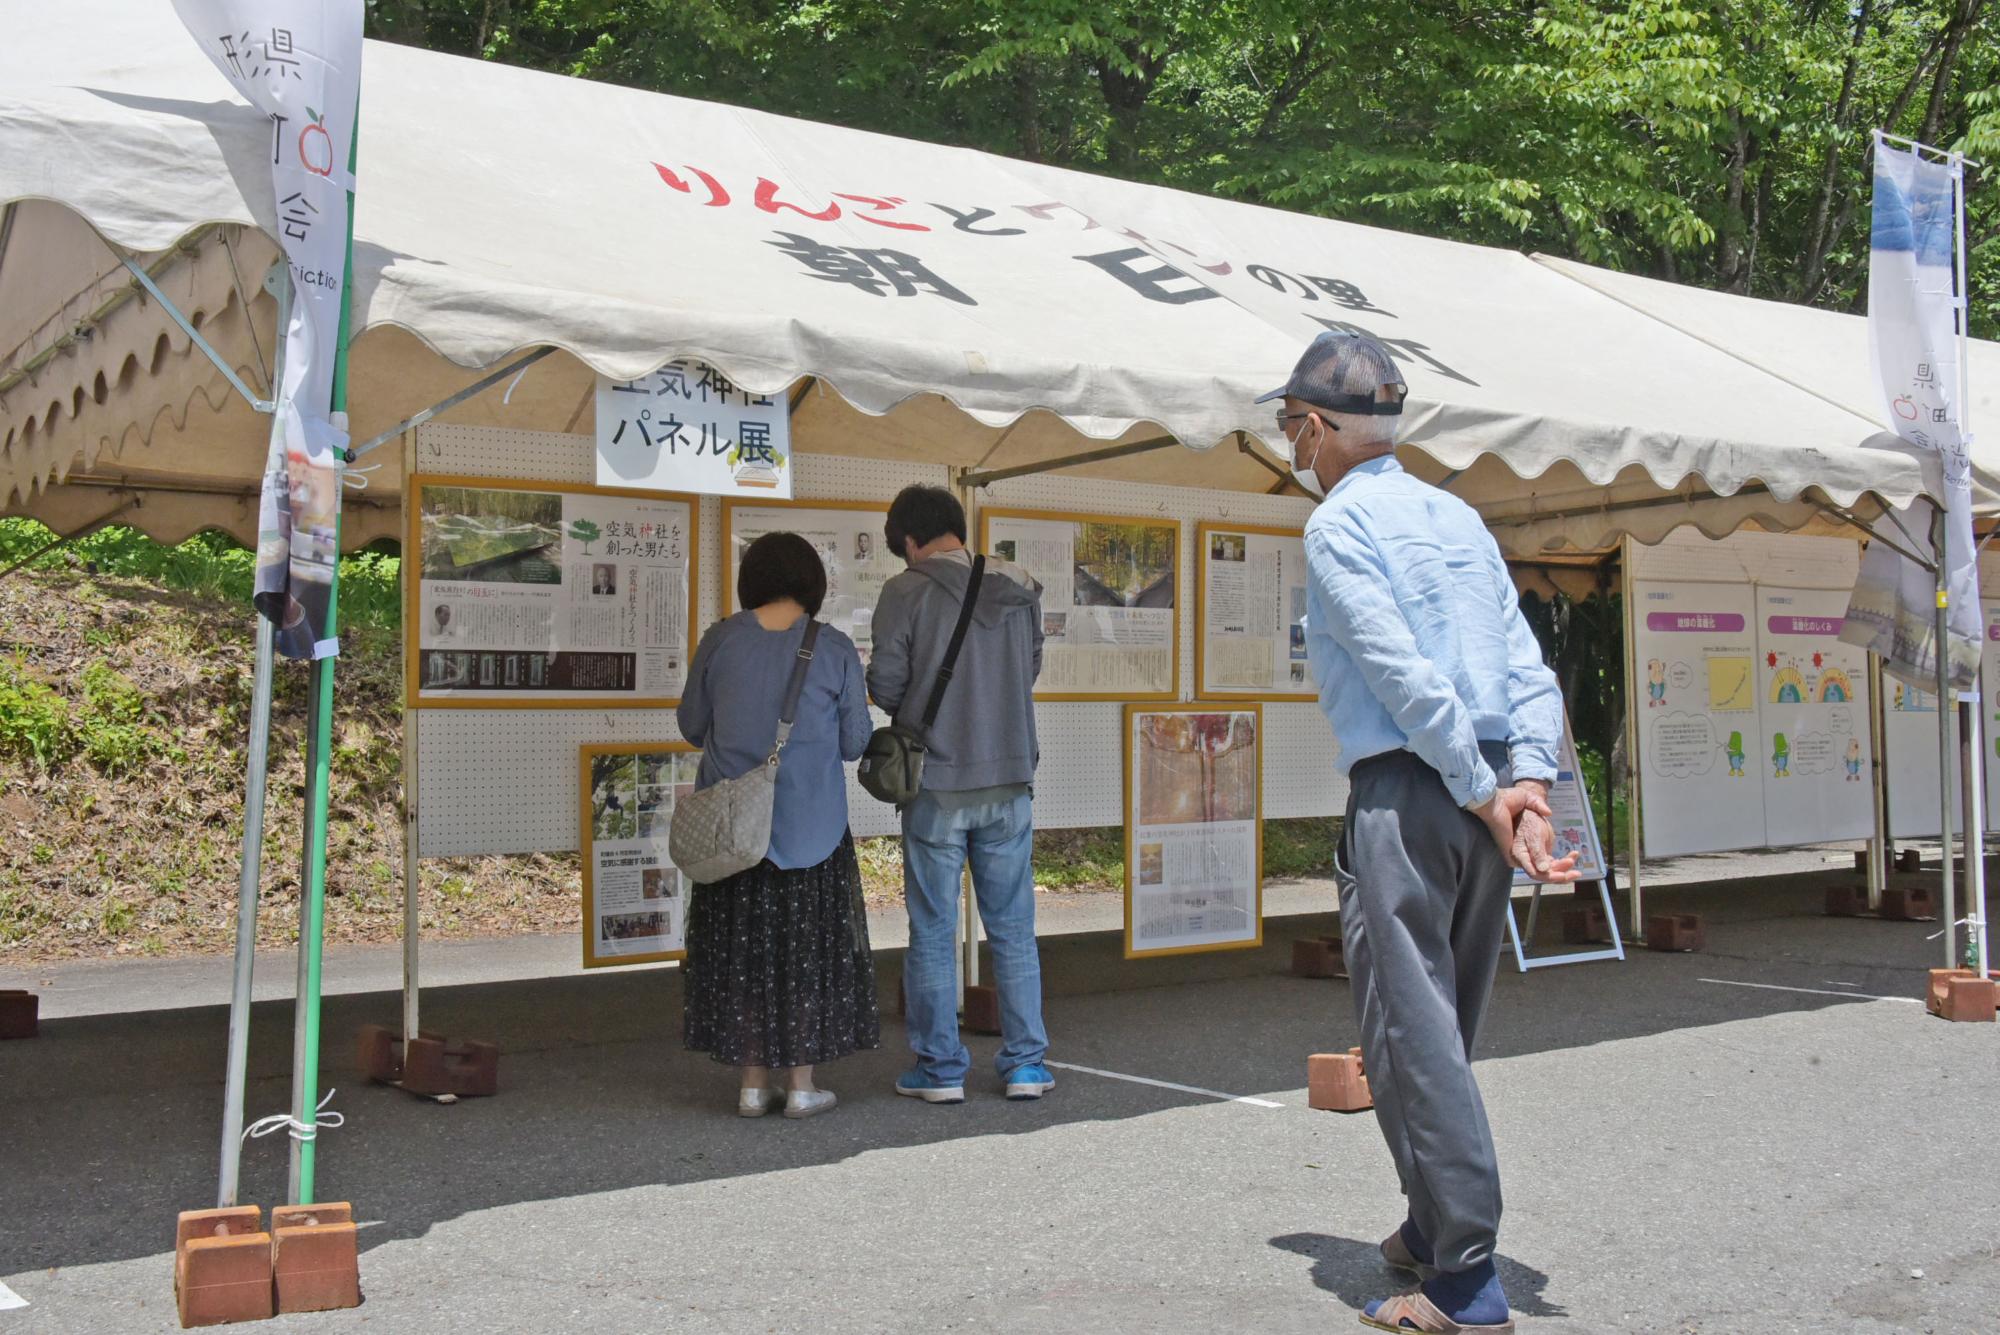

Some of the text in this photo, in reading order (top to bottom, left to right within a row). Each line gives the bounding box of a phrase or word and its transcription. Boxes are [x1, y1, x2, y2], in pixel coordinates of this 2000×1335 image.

[611, 409, 775, 464] パネル展
[606, 521, 681, 541] 空気神社を
[606, 540, 681, 559] 創った男たち
